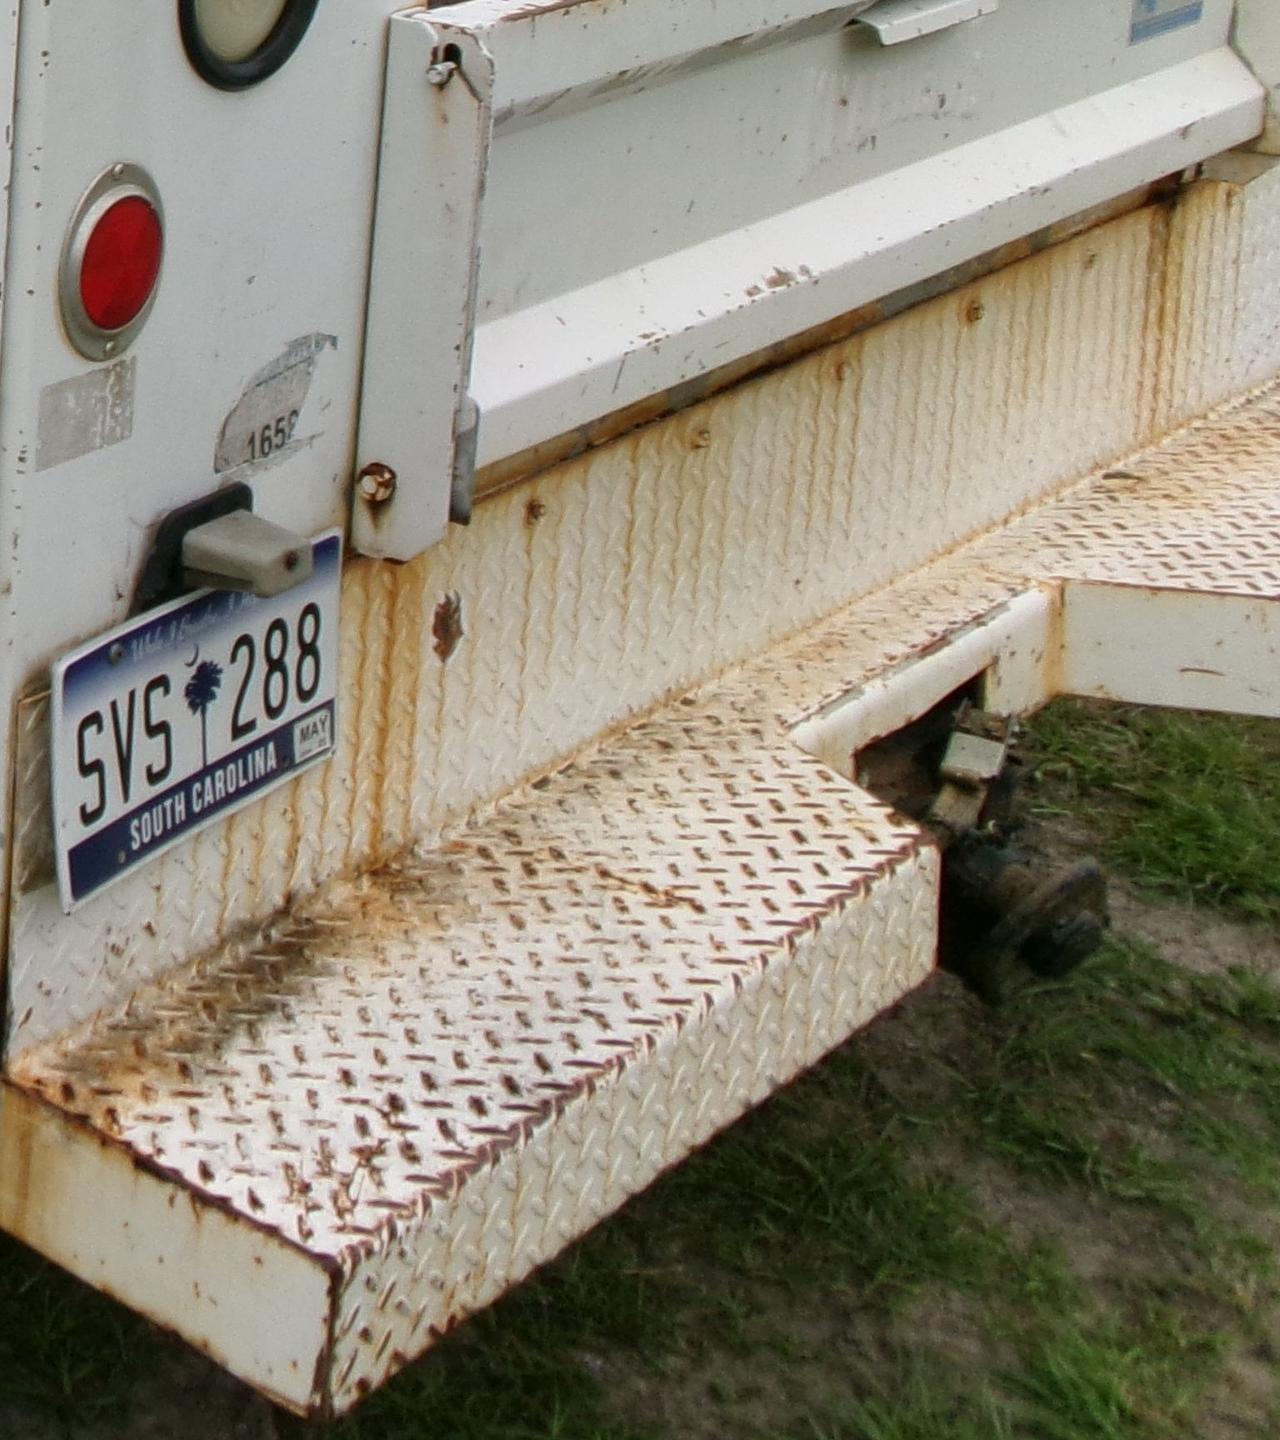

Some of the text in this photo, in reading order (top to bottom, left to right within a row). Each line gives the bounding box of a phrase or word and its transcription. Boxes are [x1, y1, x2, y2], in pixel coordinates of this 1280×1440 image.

[76, 674, 172, 828] SVS
[229, 601, 321, 742] 288
[298, 714, 330, 745] MAY
[129, 740, 277, 851] SOUTH CAROLINA
